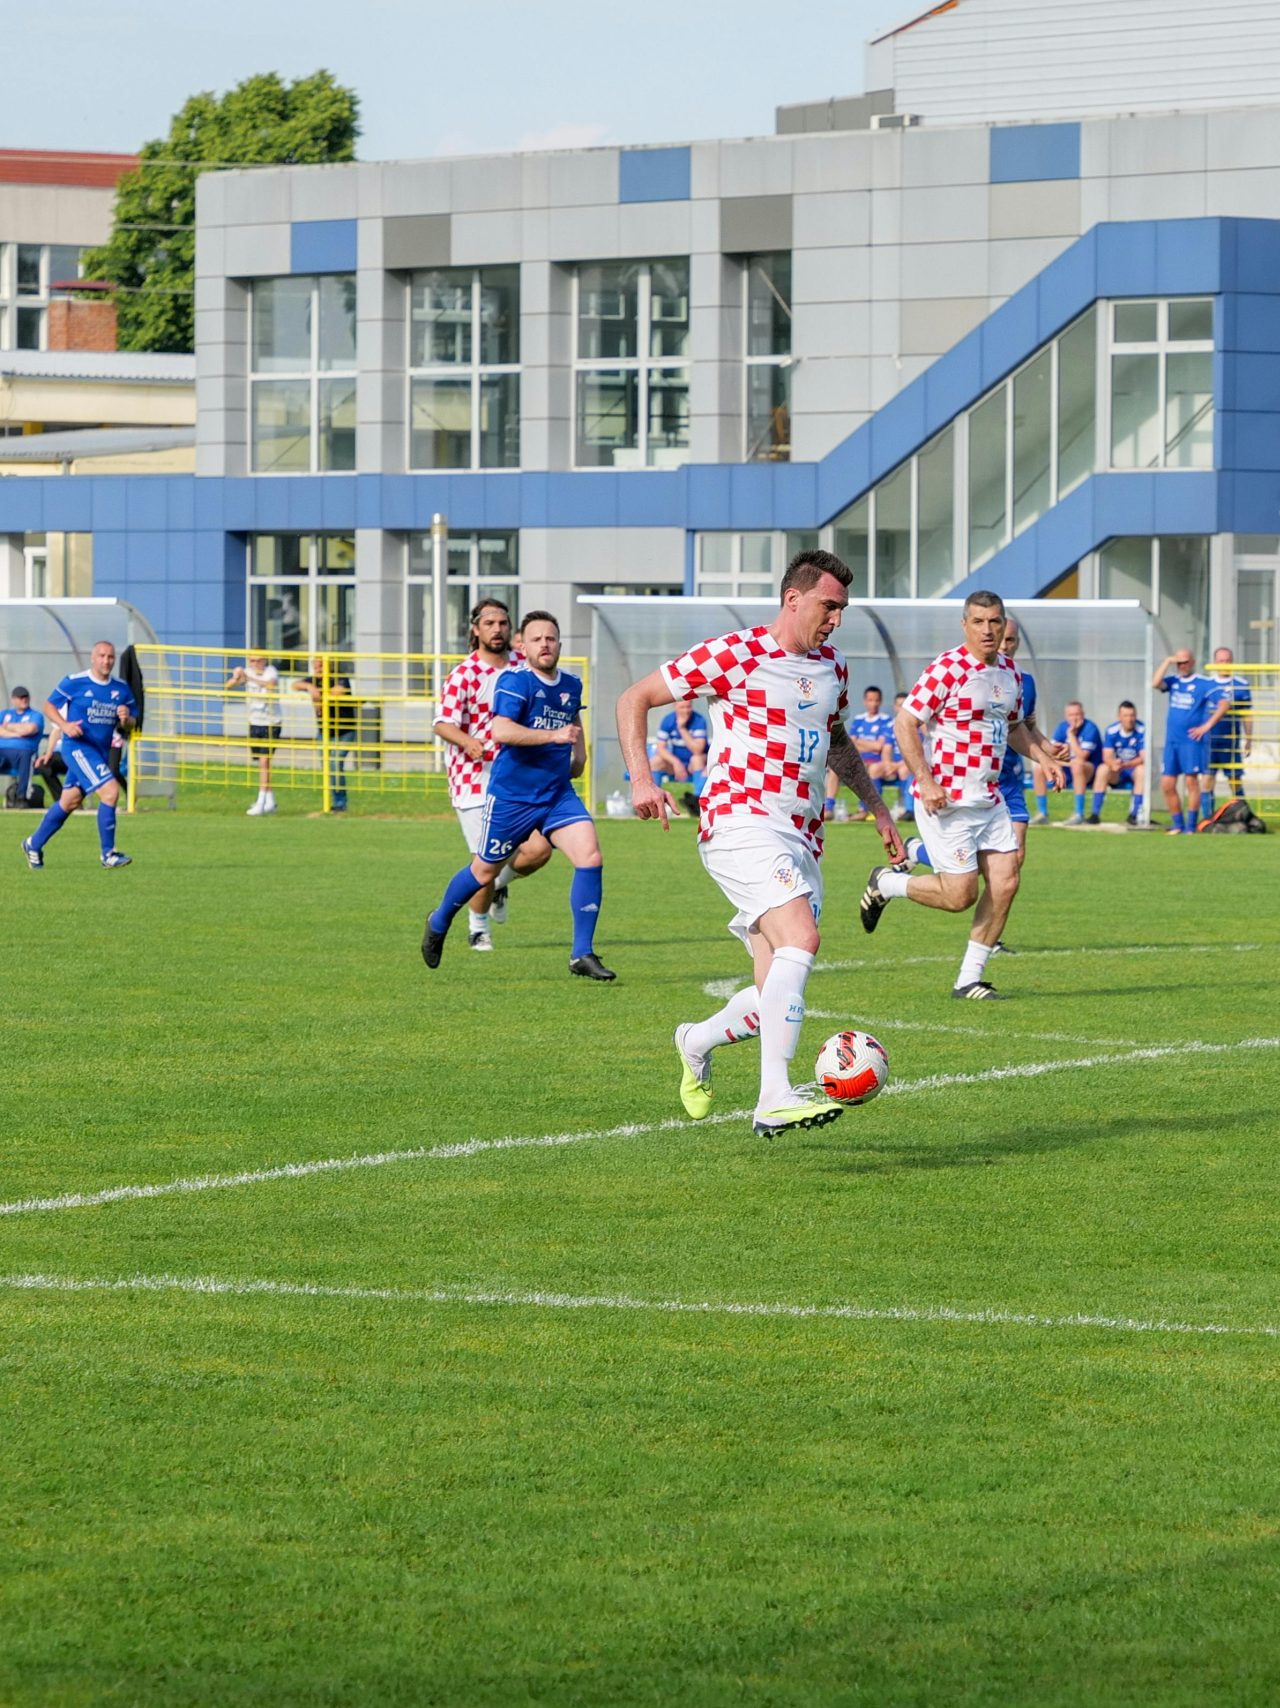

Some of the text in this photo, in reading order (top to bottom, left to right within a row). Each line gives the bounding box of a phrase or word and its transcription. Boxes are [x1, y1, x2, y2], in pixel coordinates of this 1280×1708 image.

[992, 720, 1002, 744] 11
[798, 729, 819, 763] 17
[489, 838, 512, 855] 26
